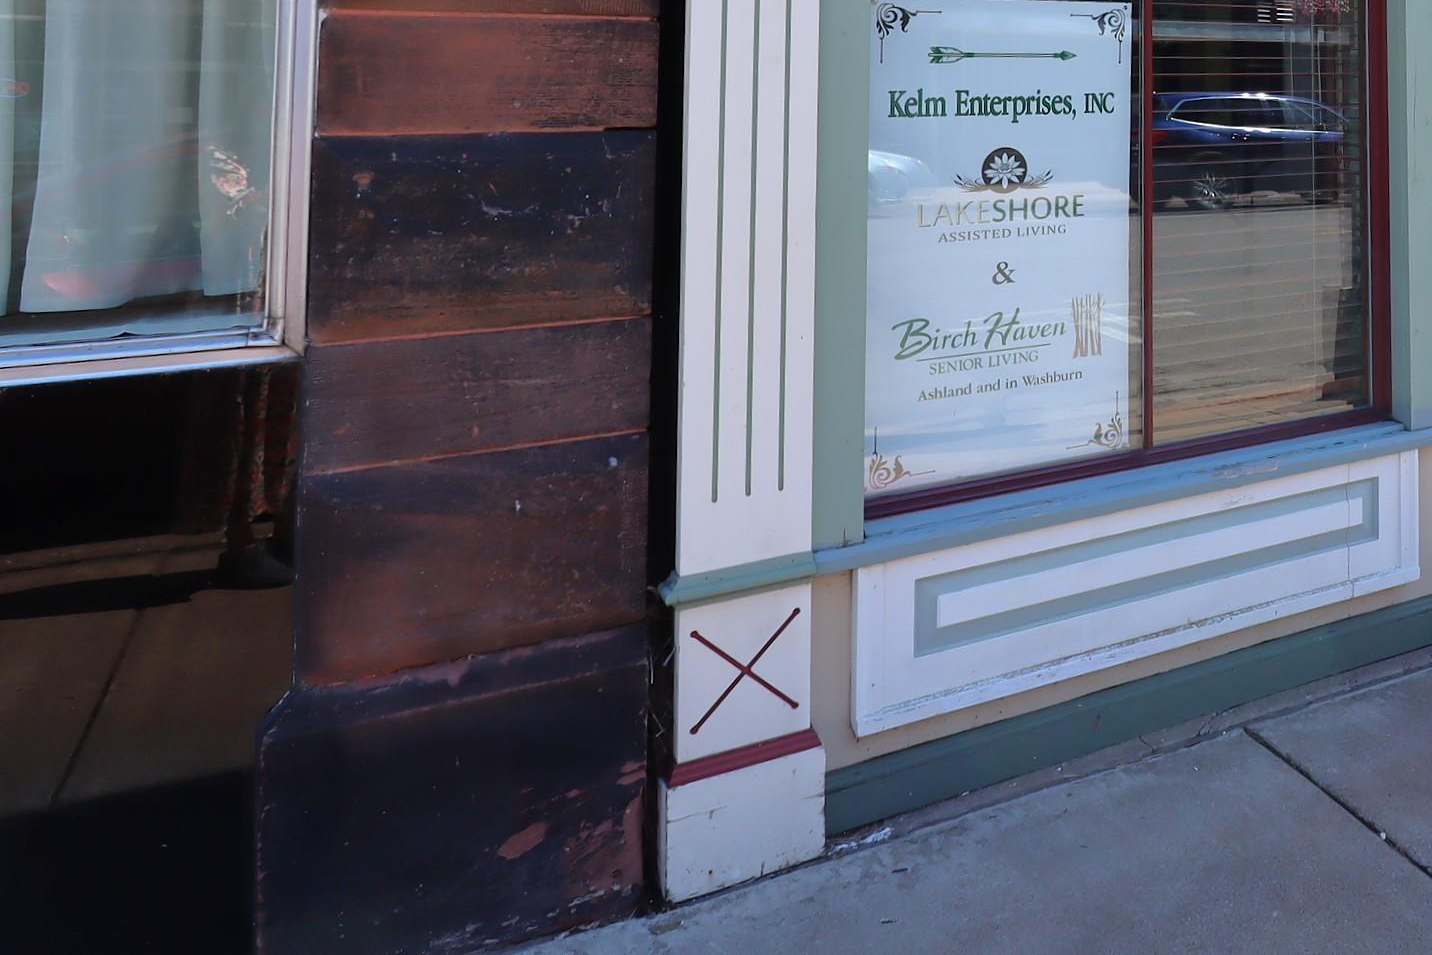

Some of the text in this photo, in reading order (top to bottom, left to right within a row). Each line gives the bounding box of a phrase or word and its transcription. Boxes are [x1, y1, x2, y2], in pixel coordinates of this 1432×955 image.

[888, 88, 1115, 123] Kelm Enterprises, INC
[916, 195, 1085, 228] LAKESHORE
[938, 223, 1067, 243] ASSISTED LIVING
[991, 261, 1016, 285] &
[891, 307, 1067, 361] Birch Haven
[928, 349, 1040, 376] SENIOR LIVING
[918, 368, 1083, 402] Ashland and in Washburn
